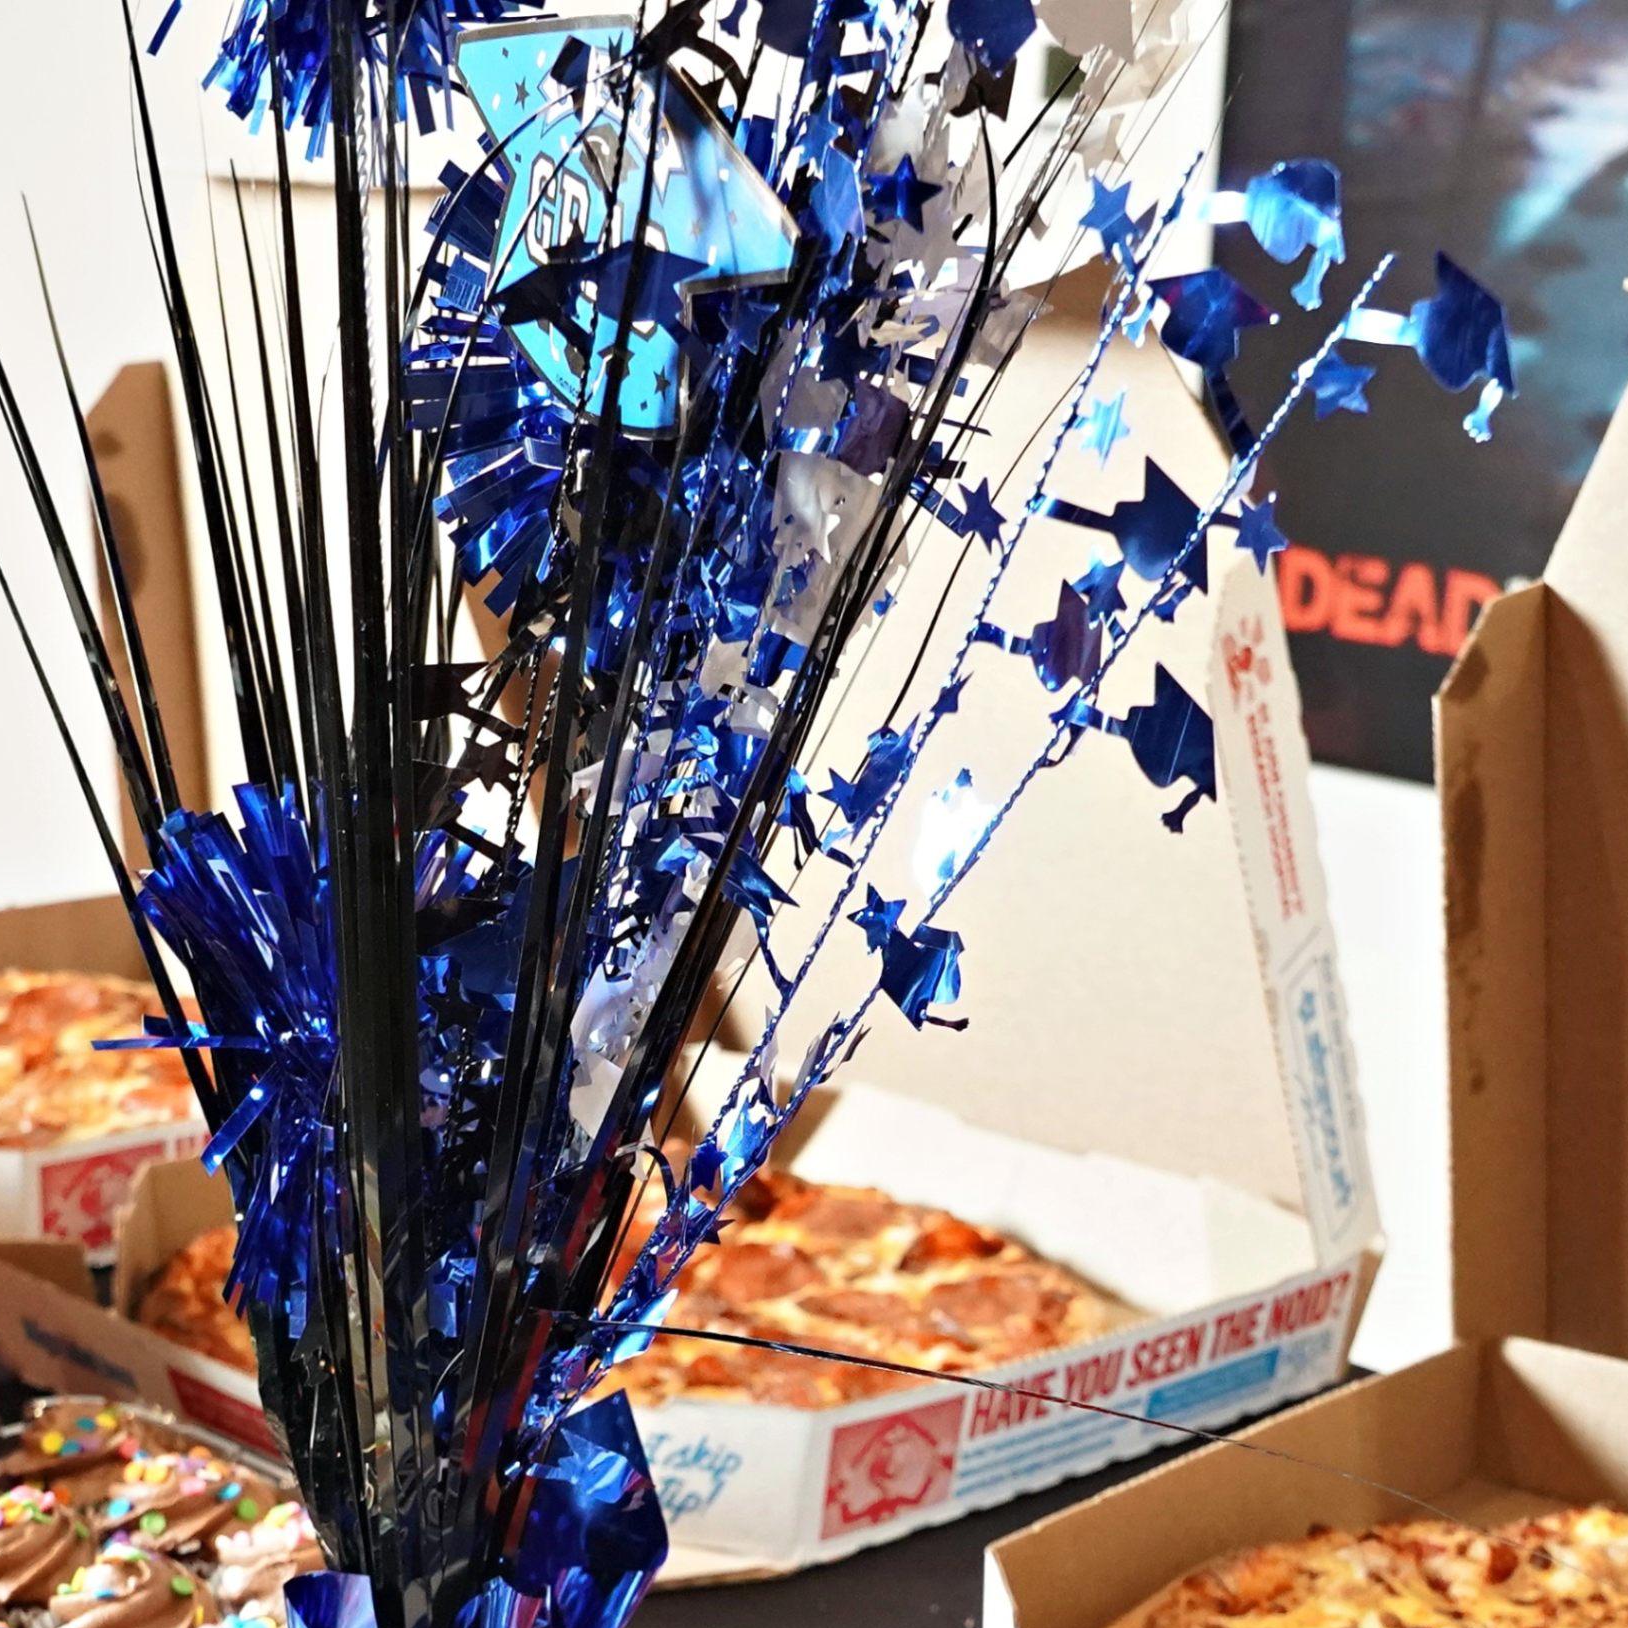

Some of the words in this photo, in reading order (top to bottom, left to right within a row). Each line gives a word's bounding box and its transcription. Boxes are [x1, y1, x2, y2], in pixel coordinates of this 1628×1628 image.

[1278, 543, 1501, 657] DEAD
[969, 1369, 1058, 1440] HAVE
[1063, 1350, 1128, 1409] YOU
[1125, 1320, 1209, 1389] SEEN
[1208, 1302, 1264, 1361] THE
[1264, 1270, 1354, 1341] NOID?
